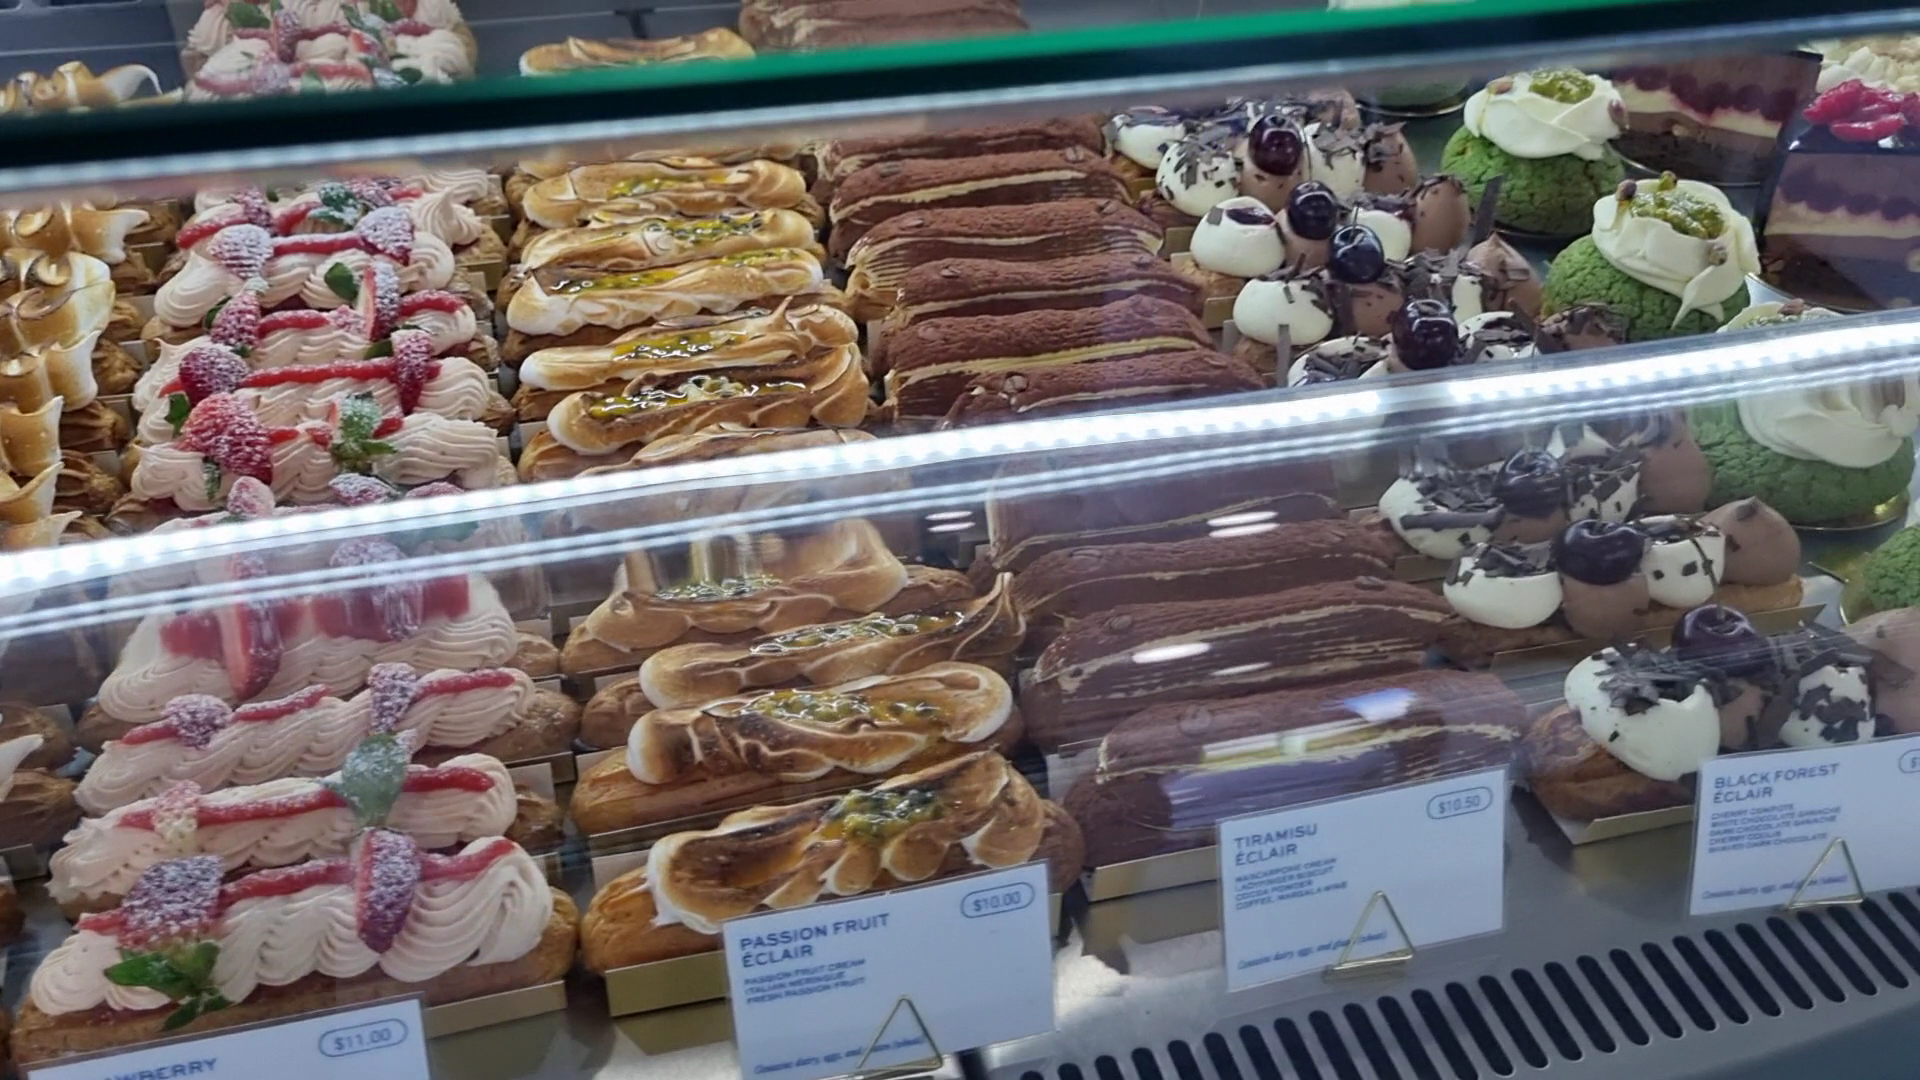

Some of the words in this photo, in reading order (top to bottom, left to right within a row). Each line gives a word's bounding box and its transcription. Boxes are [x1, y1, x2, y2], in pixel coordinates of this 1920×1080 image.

[1715, 772, 1771, 789] BLACK
[1774, 762, 1840, 781] FOREST
[1439, 795, 1480, 814] $10.50
[1234, 823, 1317, 849] TIRAMISU
[1235, 843, 1298, 867] ÉCLAIR
[973, 891, 1022, 912] $10.00
[740, 924, 828, 951] PASSION
[832, 913, 890, 935] FRUIT
[742, 944, 813, 968] ÉCLAIR
[334, 1028, 392, 1051] $11.00
